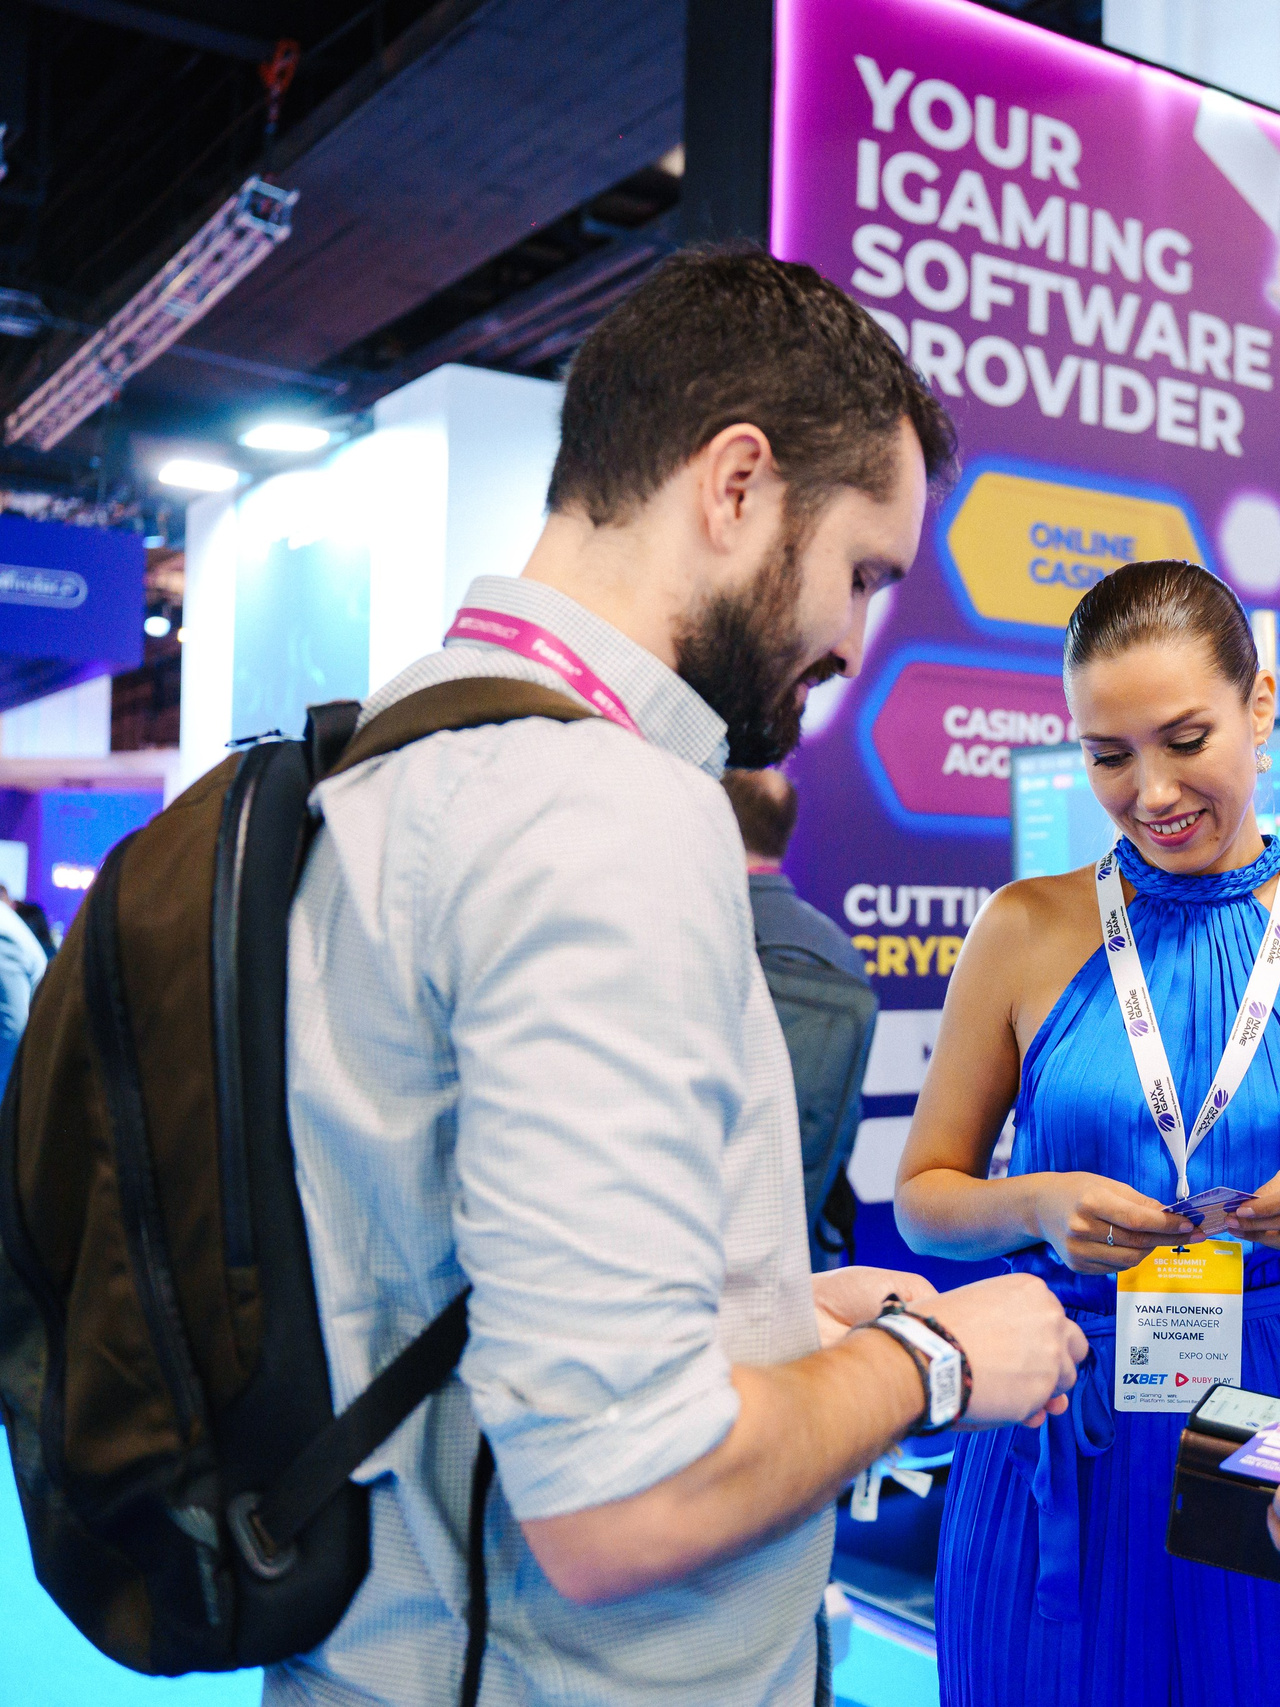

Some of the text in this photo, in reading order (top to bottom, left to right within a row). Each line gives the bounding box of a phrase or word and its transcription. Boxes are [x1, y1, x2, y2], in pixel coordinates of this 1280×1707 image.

[855, 53, 1081, 190] YOUR
[856, 138, 1193, 294] IGAMING
[852, 223, 1272, 393] SOFTWARE
[1029, 520, 1136, 563] ONLINE
[942, 704, 1065, 746] CASINO
[1106, 919, 1114, 938] NUX
[1110, 909, 1121, 935] GAME
[1267, 938, 1280, 964] GAME
[1125, 1000, 1135, 1021] NUX
[1129, 989, 1143, 1018] GAME
[1239, 1017, 1251, 1046] GAME
[1248, 1019, 1261, 1041] NUX
[1150, 1091, 1162, 1115] NUX
[1154, 1079, 1168, 1111] GAME
[1173, 1258, 1207, 1266] SUMMIT
[1135, 1305, 1223, 1315] YANA FILONENKO
[1137, 1318, 1220, 1328] SALES MANAGER
[1152, 1332, 1205, 1341] NUXGAME
[1179, 1352, 1229, 1361] EXPO ONLY
[1122, 1373, 1169, 1385] 1XBET
